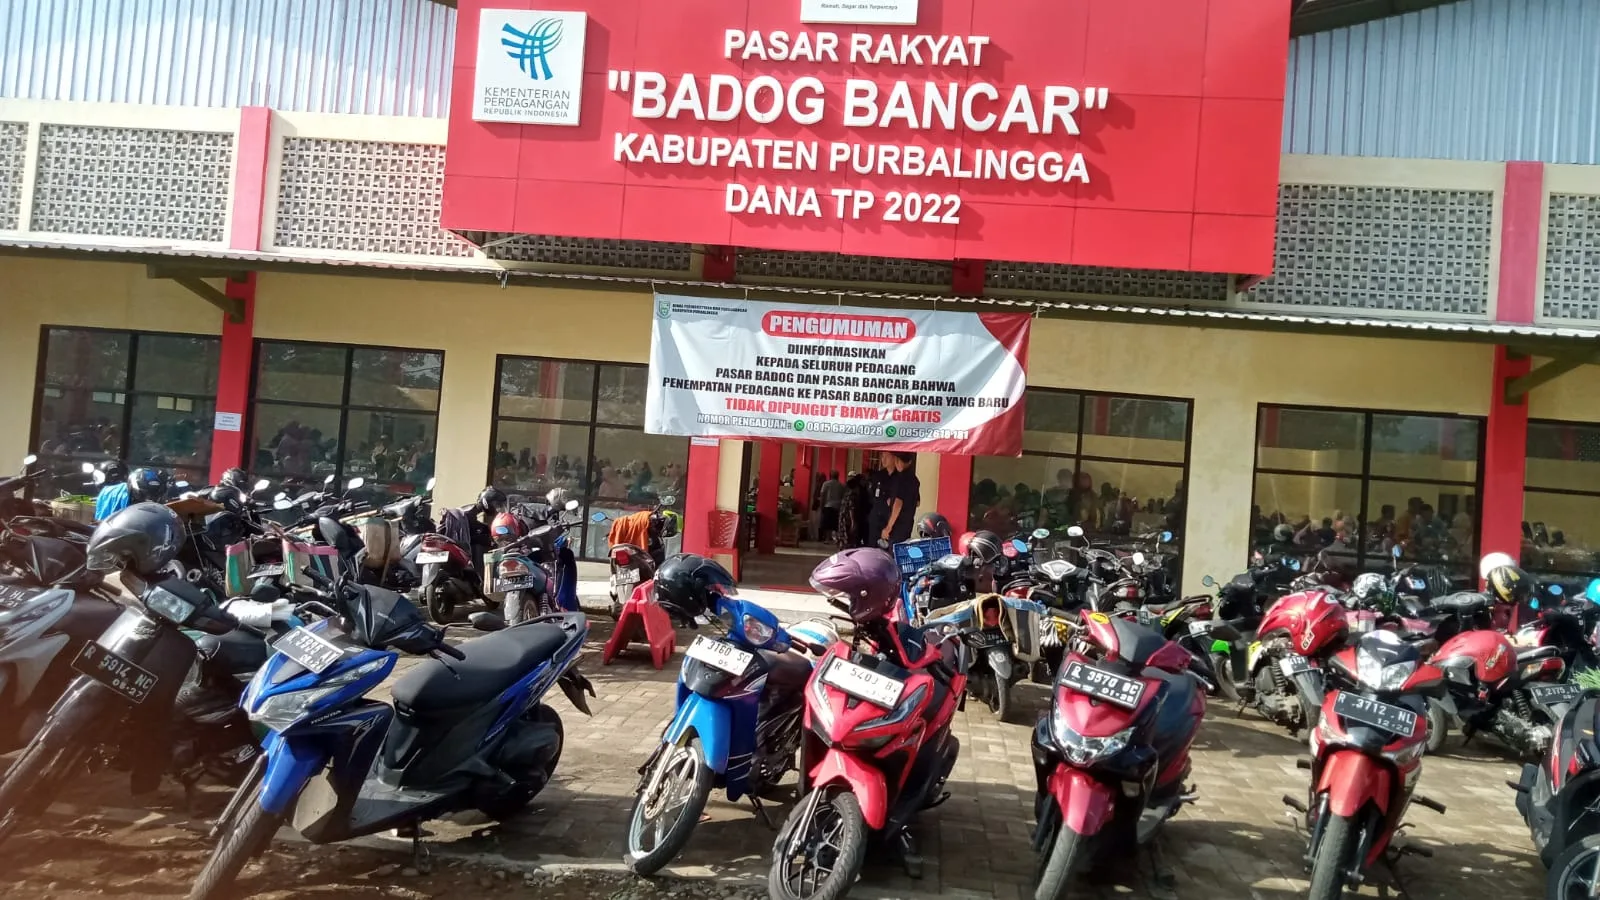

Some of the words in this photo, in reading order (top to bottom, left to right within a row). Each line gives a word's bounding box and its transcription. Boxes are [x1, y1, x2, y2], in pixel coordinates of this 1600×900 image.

[724, 28, 839, 62] PASAR
[850, 32, 990, 66] RAKYAT
[484, 97, 569, 110] PERDAGANGAN
[485, 87, 570, 99] KEMENTERIAN
[608, 69, 825, 125] "BADOG
[843, 78, 1109, 135] BANCAR"
[484, 107, 522, 116] REPUBLIK
[524, 110, 568, 118] INDONESIA
[613, 132, 818, 171] KABUPATEN
[829, 142, 1090, 184] PURBALINGGA
[724, 183, 822, 218] DANA
[832, 188, 874, 219] TP
[882, 191, 961, 225] 2022
[769, 315, 908, 339] PENGUMUMAN
[788, 343, 886, 359] DIINFORMASIKAN
[756, 356, 799, 369] KEPADA
[801, 359, 853, 372] SELURUH
[855, 363, 916, 376] PEDAGANG
[716, 367, 753, 379] PASAR
[755, 371, 794, 383] BADOG
[796, 374, 820, 385] DAN
[822, 375, 859, 387] PASAR
[862, 378, 909, 390] BANCAR
[912, 381, 956, 392] BAHWA
[663, 377, 732, 393] PENEMPATAN
[735, 383, 795, 398] PEDAGANG
[797, 388, 811, 400] KE
[814, 389, 850, 402] PASAR
[853, 392, 893, 404] BADOG
[895, 394, 943, 407] BANCAR
[945, 397, 975, 408] YANG
[978, 398, 1009, 409] BARU
[697, 414, 731, 425] NOMOR
[725, 398, 765, 412] TIDAK
[768, 402, 837, 417] DIPUNGUT
[840, 406, 879, 420] BIAYA
[881, 409, 889, 420] /
[892, 409, 942, 423] GRATIS
[807, 422, 831, 432] 0815
[832, 423, 857, 434] 6821
[857, 425, 883, 436] 4028
[695, 636, 704, 646] R
[707, 640, 732, 656] 3160
[736, 652, 751, 664] SC
[84, 645, 97, 660] R
[101, 654, 131, 678] 5914
[135, 673, 153, 690] NC
[834, 661, 842, 671] R
[1071, 665, 1082, 679] R
[1337, 692, 1346, 704] R
[1355, 698, 1387, 716] 3712
[1398, 711, 1413, 725] NL
